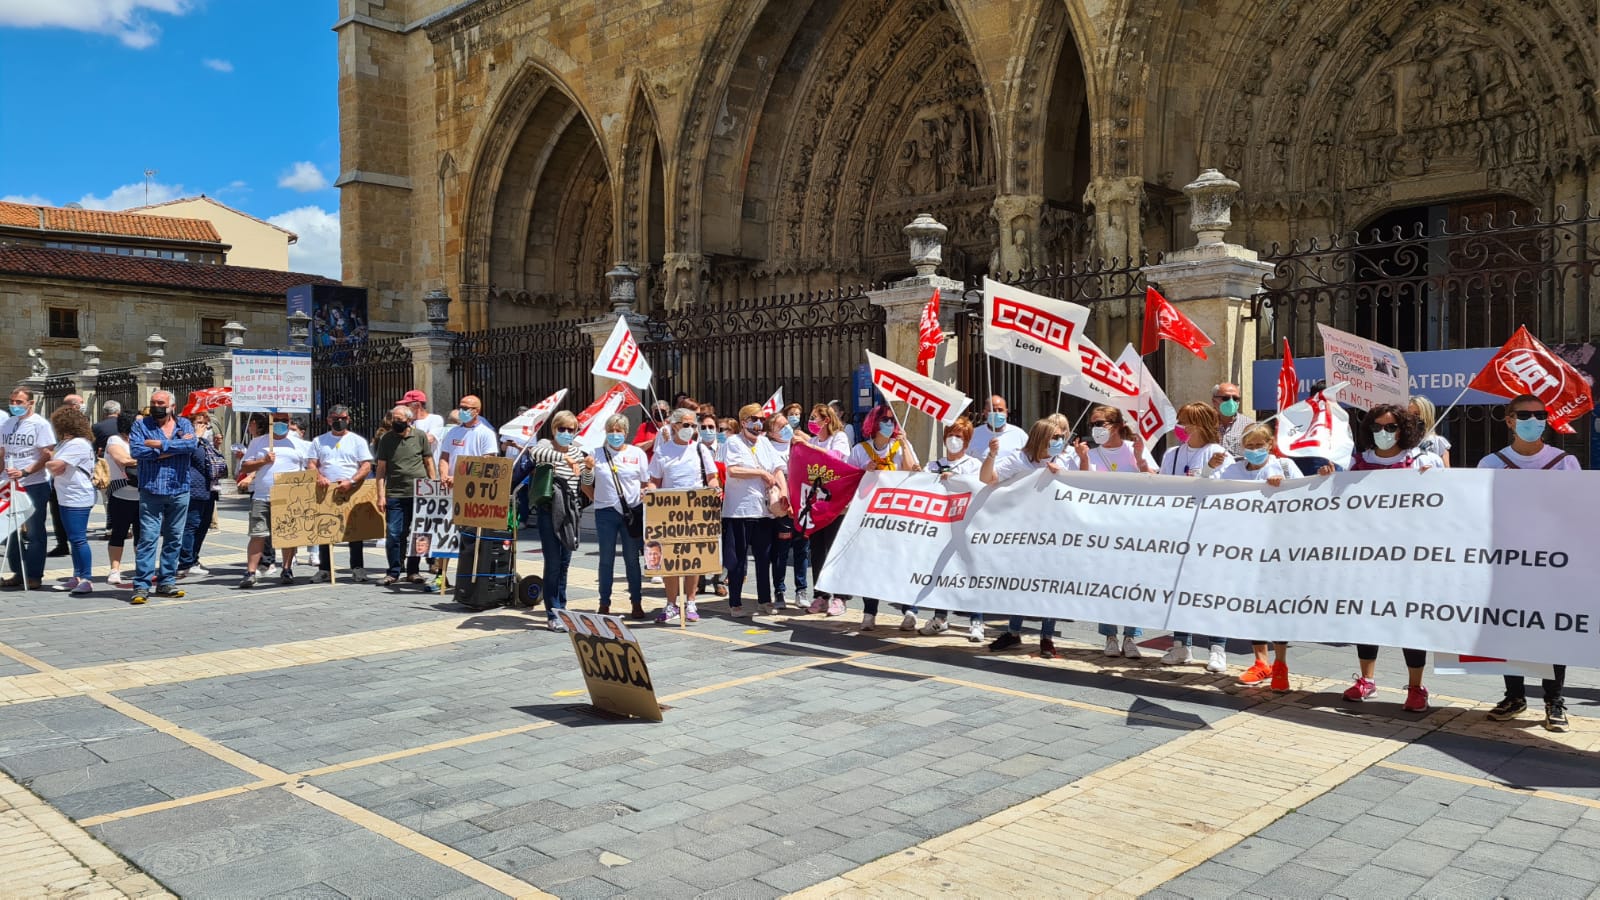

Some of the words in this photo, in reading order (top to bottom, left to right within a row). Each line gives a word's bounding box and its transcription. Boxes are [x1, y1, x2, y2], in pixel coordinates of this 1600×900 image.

[998, 302, 1066, 347] CCOO
[1333, 370, 1374, 393] AHORA
[1409, 372, 1477, 390] ATEDRA
[1504, 352, 1560, 397] UGT
[878, 371, 943, 417] CCOO
[459, 461, 509, 479] OVEJERO
[465, 481, 475, 498] O
[480, 480, 498, 500] TÚ
[1054, 488, 1073, 502] LA
[1078, 491, 1166, 508] PLANTILLA
[1171, 496, 1195, 509] DE
[1200, 496, 1340, 514] LABORATOROS
[1346, 492, 1444, 510] OVEJERO
[416, 498, 449, 515] POR
[463, 502, 508, 519] NOSOTROS
[873, 491, 947, 517] CCOO
[859, 514, 938, 537] industria
[437, 532, 459, 551] YA
[673, 543, 691, 554] EN
[696, 542, 717, 555] TU
[970, 532, 991, 545] EN
[993, 532, 1057, 546] DEFENSA
[1061, 533, 1084, 547] DE
[1086, 534, 1110, 549] SU
[1113, 536, 1190, 555] SALARIO
[1197, 542, 1208, 557] Y
[1213, 544, 1254, 562] POR
[1259, 548, 1282, 563] LA
[1288, 545, 1407, 561] VIABILIDAD
[1413, 545, 1457, 563] DEL
[1463, 547, 1569, 568] EMPLEO
[909, 572, 933, 586] NO
[935, 573, 967, 589] MÁS
[968, 575, 1156, 603] DESINDUSTRIALIZACIÓN
[1163, 590, 1175, 605] Y
[1178, 591, 1329, 615] DESPOBLACIÓN
[1335, 599, 1364, 615] EN
[1370, 600, 1398, 617] LA
[1404, 601, 1546, 630] PROVINCIA
[1554, 612, 1590, 634] DE
[573, 632, 653, 692] RATA
